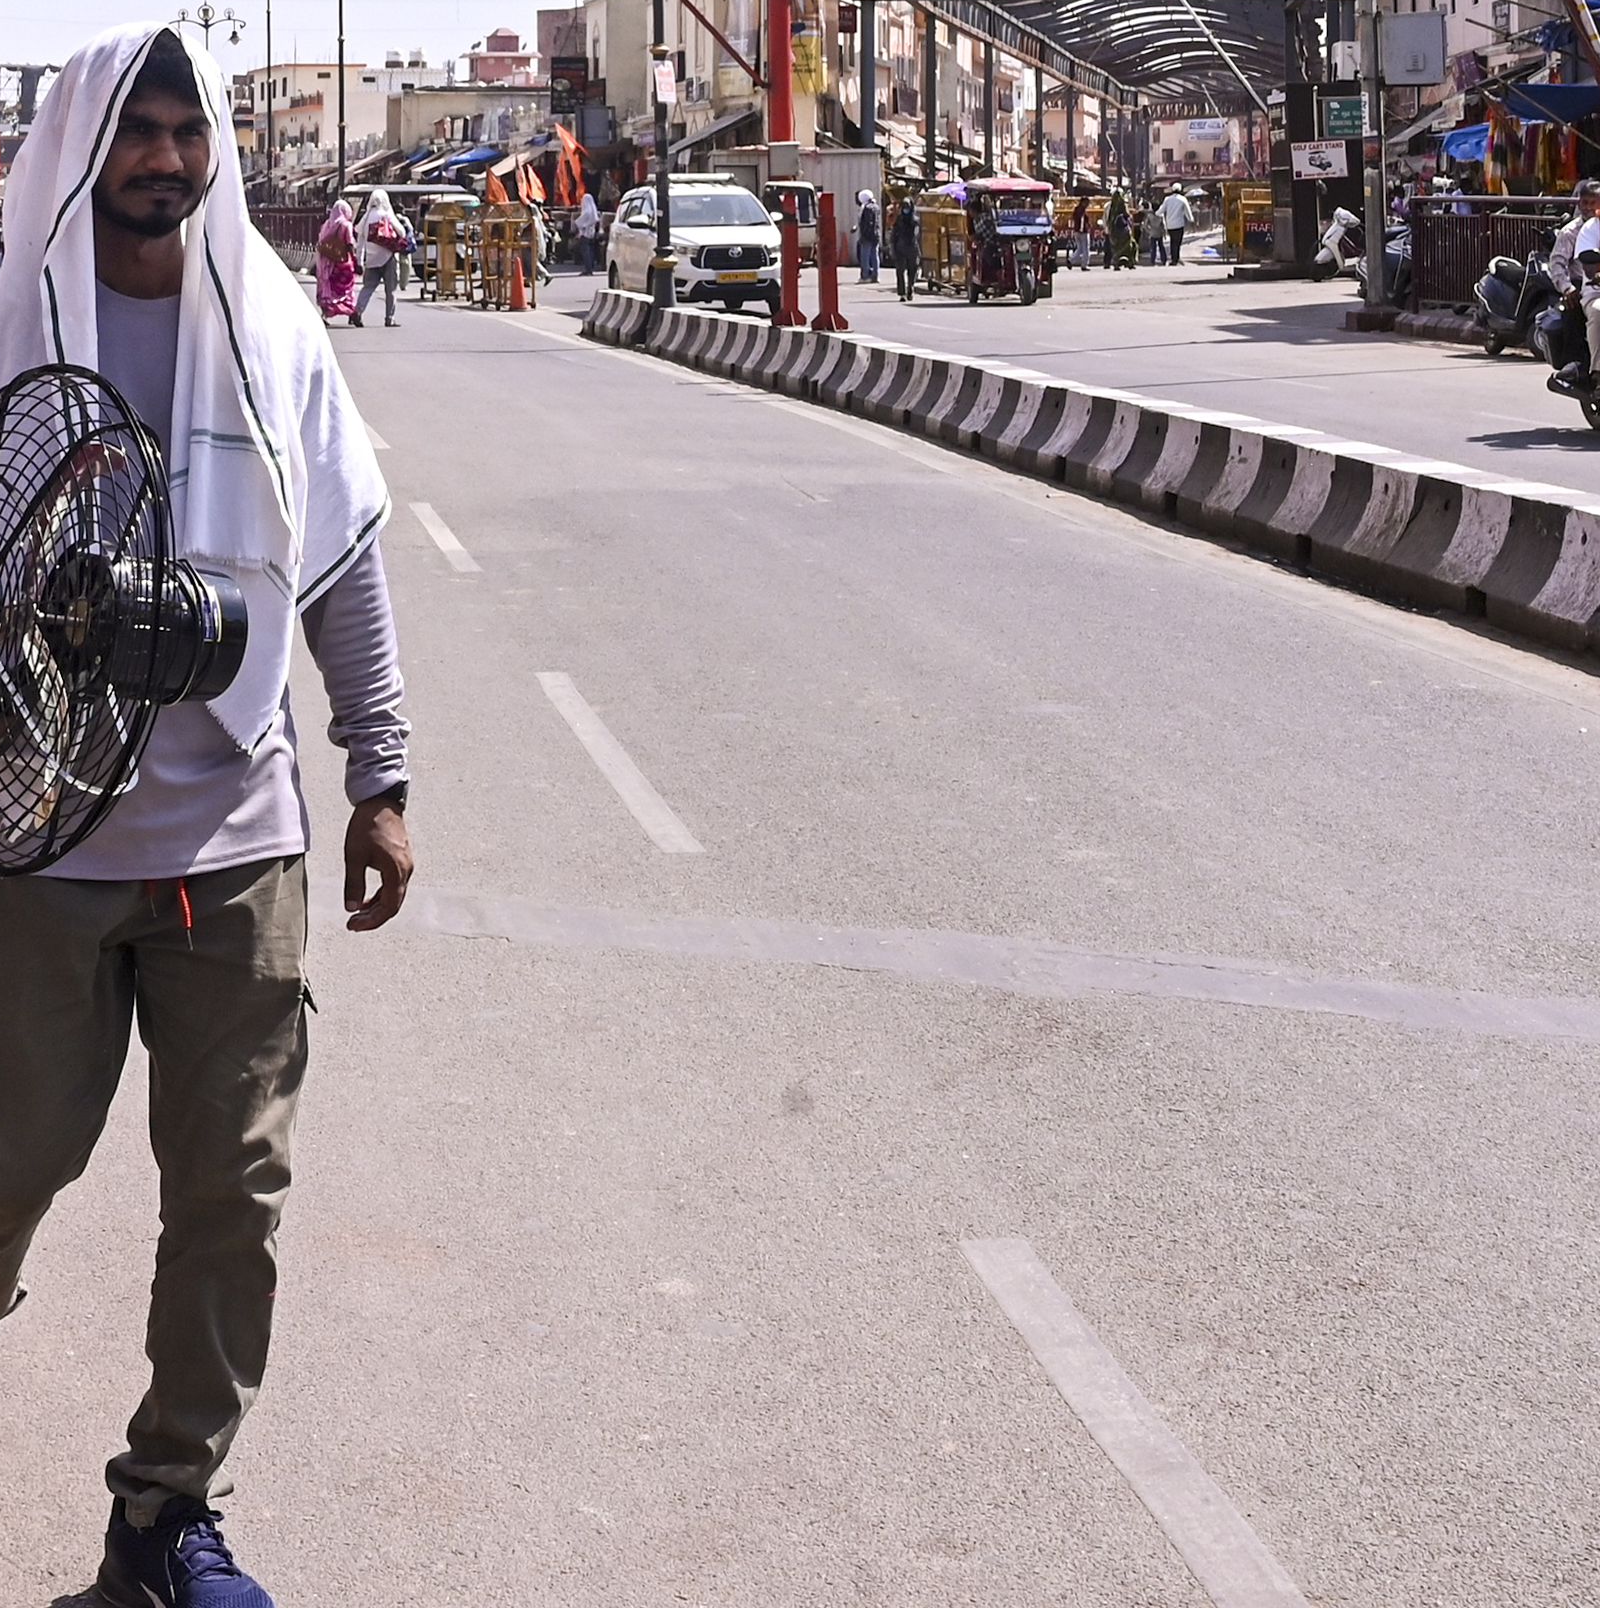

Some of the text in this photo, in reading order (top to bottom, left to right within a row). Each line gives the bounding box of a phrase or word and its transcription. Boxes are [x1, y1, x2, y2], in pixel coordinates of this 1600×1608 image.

[1292, 141, 1344, 152] GOLF CART STAND
